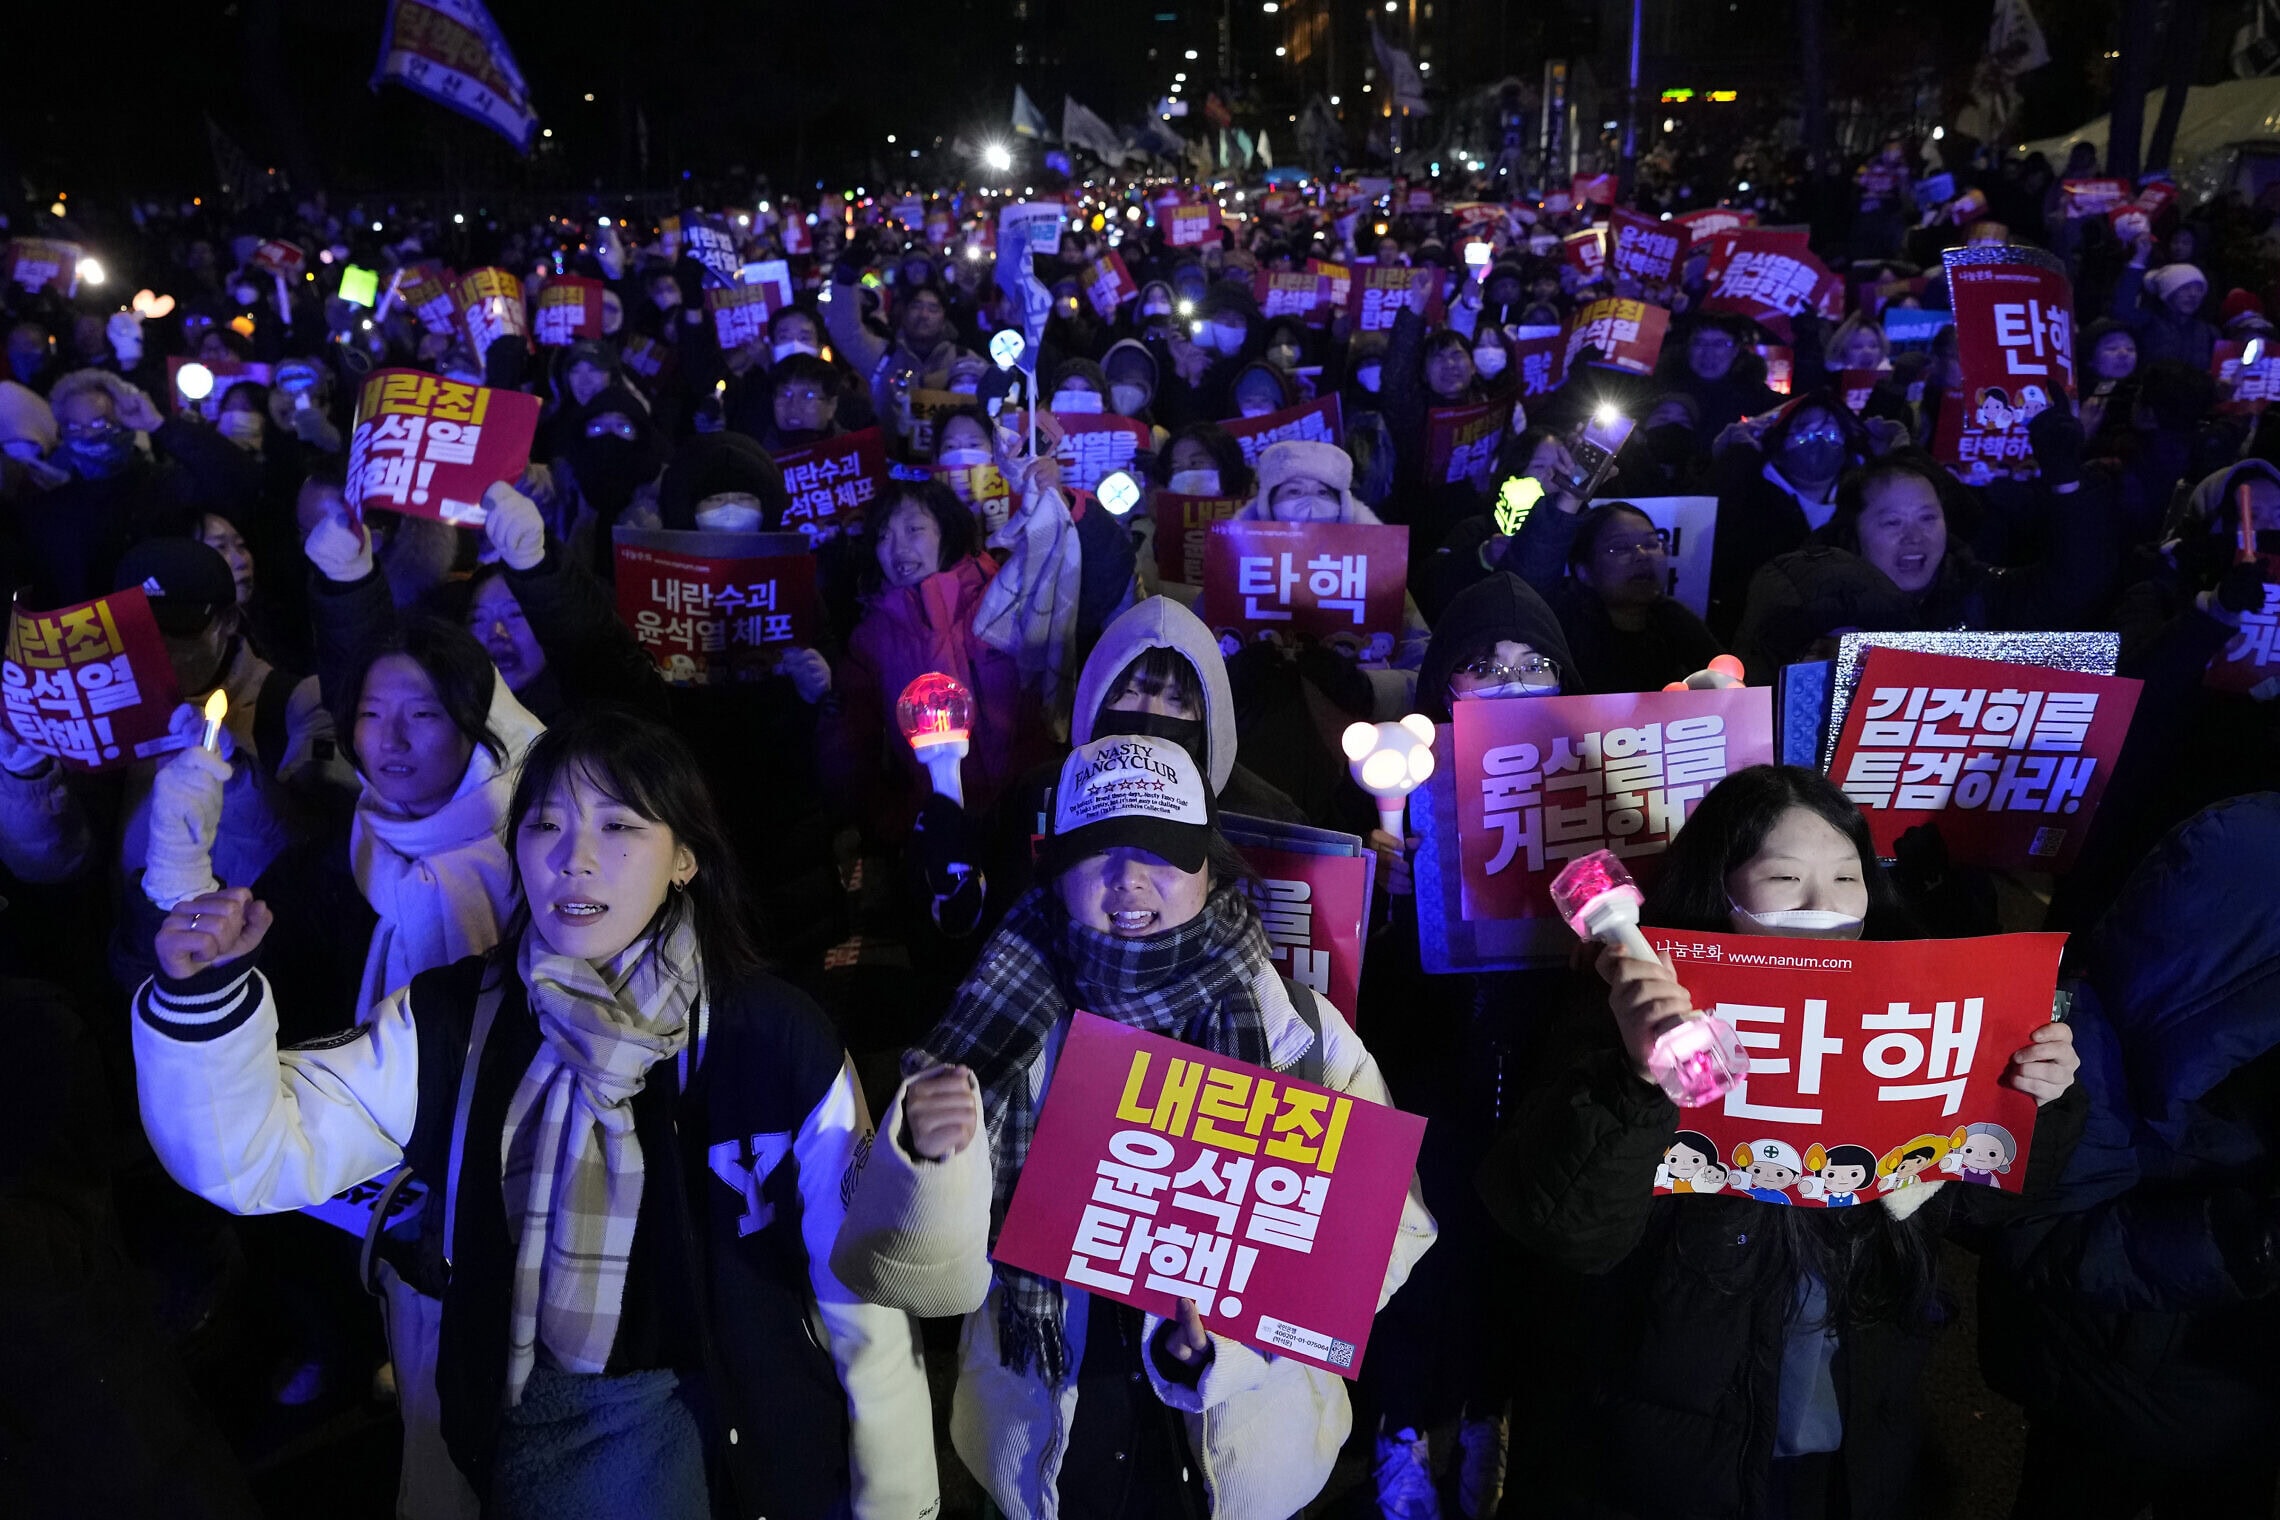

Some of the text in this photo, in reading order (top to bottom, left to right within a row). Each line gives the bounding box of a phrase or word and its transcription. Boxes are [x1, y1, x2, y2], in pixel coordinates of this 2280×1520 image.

[1993, 299, 2074, 386] 탄핵
[1057, 429, 1136, 463] 석열을
[651, 578, 777, 617] 내란수괴
[1239, 552, 1368, 625] 탄핵
[634, 610, 794, 652] 윤석열 체포
[1095, 743, 1153, 761] NASTY
[1858, 686, 2100, 753] 김건희를
[1482, 715, 1729, 812] 윤석열을
[1841, 751, 2098, 815] 특검하라!
[1656, 939, 1852, 969] 나눔문화 www.nanum.com
[1715, 997, 1984, 1126] 탄핵
[1114, 1049, 1352, 1175] 내란죄
[1091, 1129, 1331, 1255] 윤석열
[1064, 1203, 1259, 1320] 탄핵!
